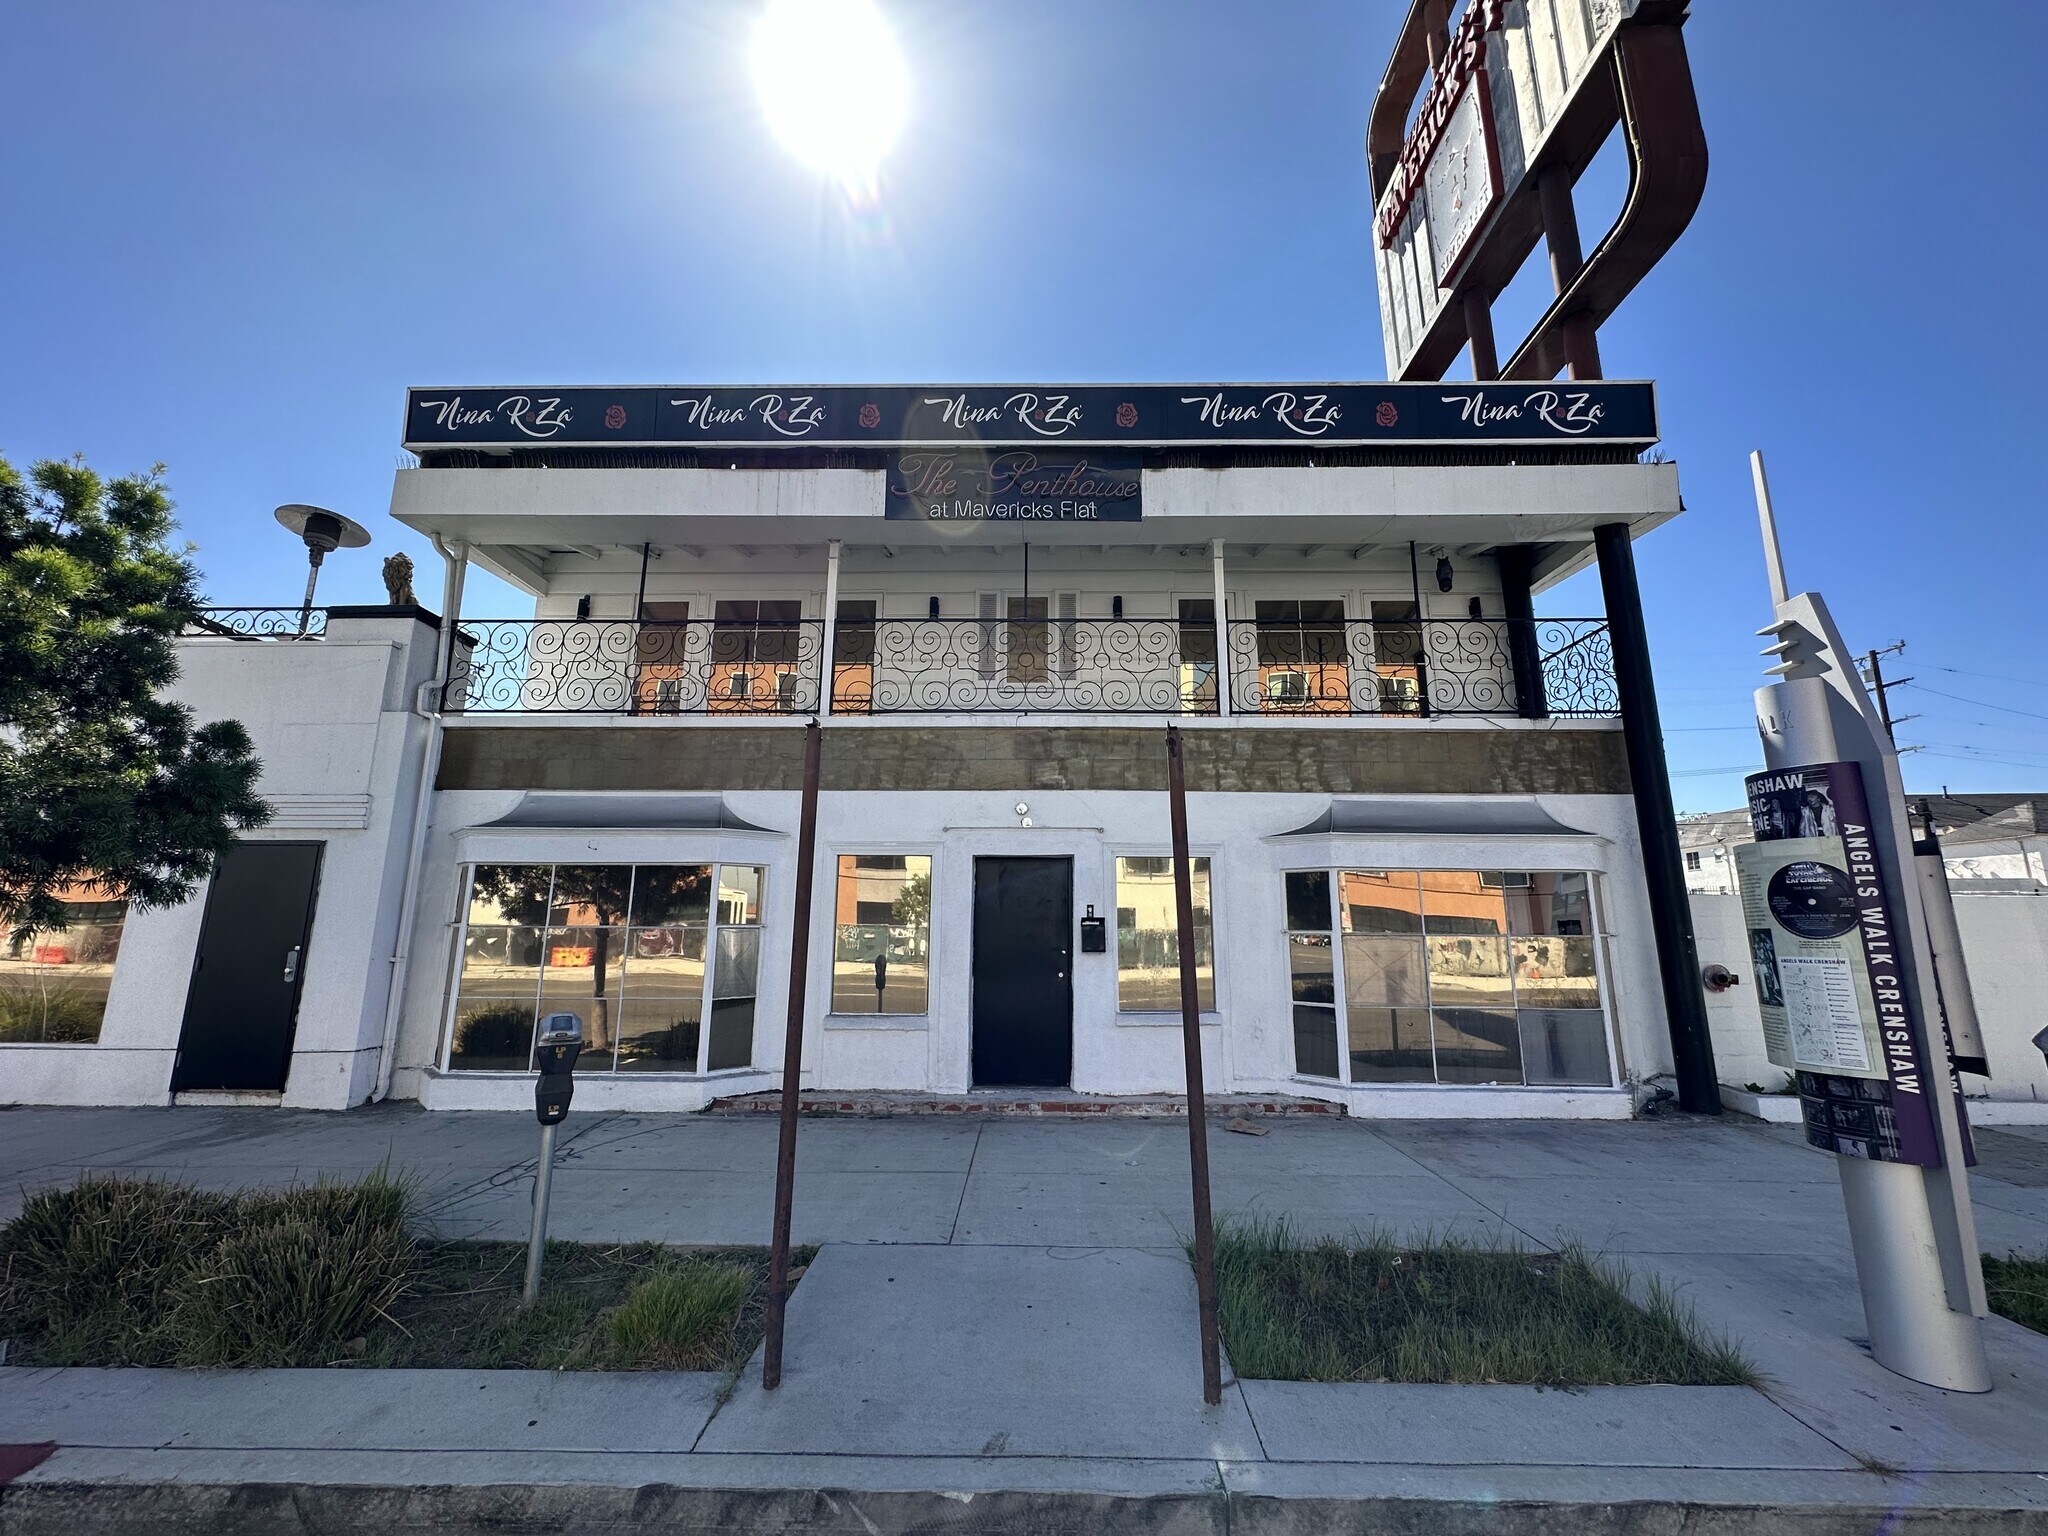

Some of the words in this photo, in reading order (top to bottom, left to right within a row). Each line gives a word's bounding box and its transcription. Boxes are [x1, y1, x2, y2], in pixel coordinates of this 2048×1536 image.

[420, 396, 495, 431] Nina
[671, 394, 748, 430] Nina
[924, 393, 1002, 429] Nina
[1181, 392, 1261, 428] Nina
[1441, 391, 1523, 427] Nina
[891, 453, 957, 496] The
[977, 452, 1139, 497] Penthouse
[930, 501, 949, 518] at
[954, 500, 1054, 519] Mavericks
[1061, 500, 1098, 519] Flat
[1751, 797, 1767, 814] SIC
[1843, 823, 1879, 897] ANGELS
[1861, 907, 1893, 965] WALK
[1875, 975, 1920, 1094] CRENSHAW
